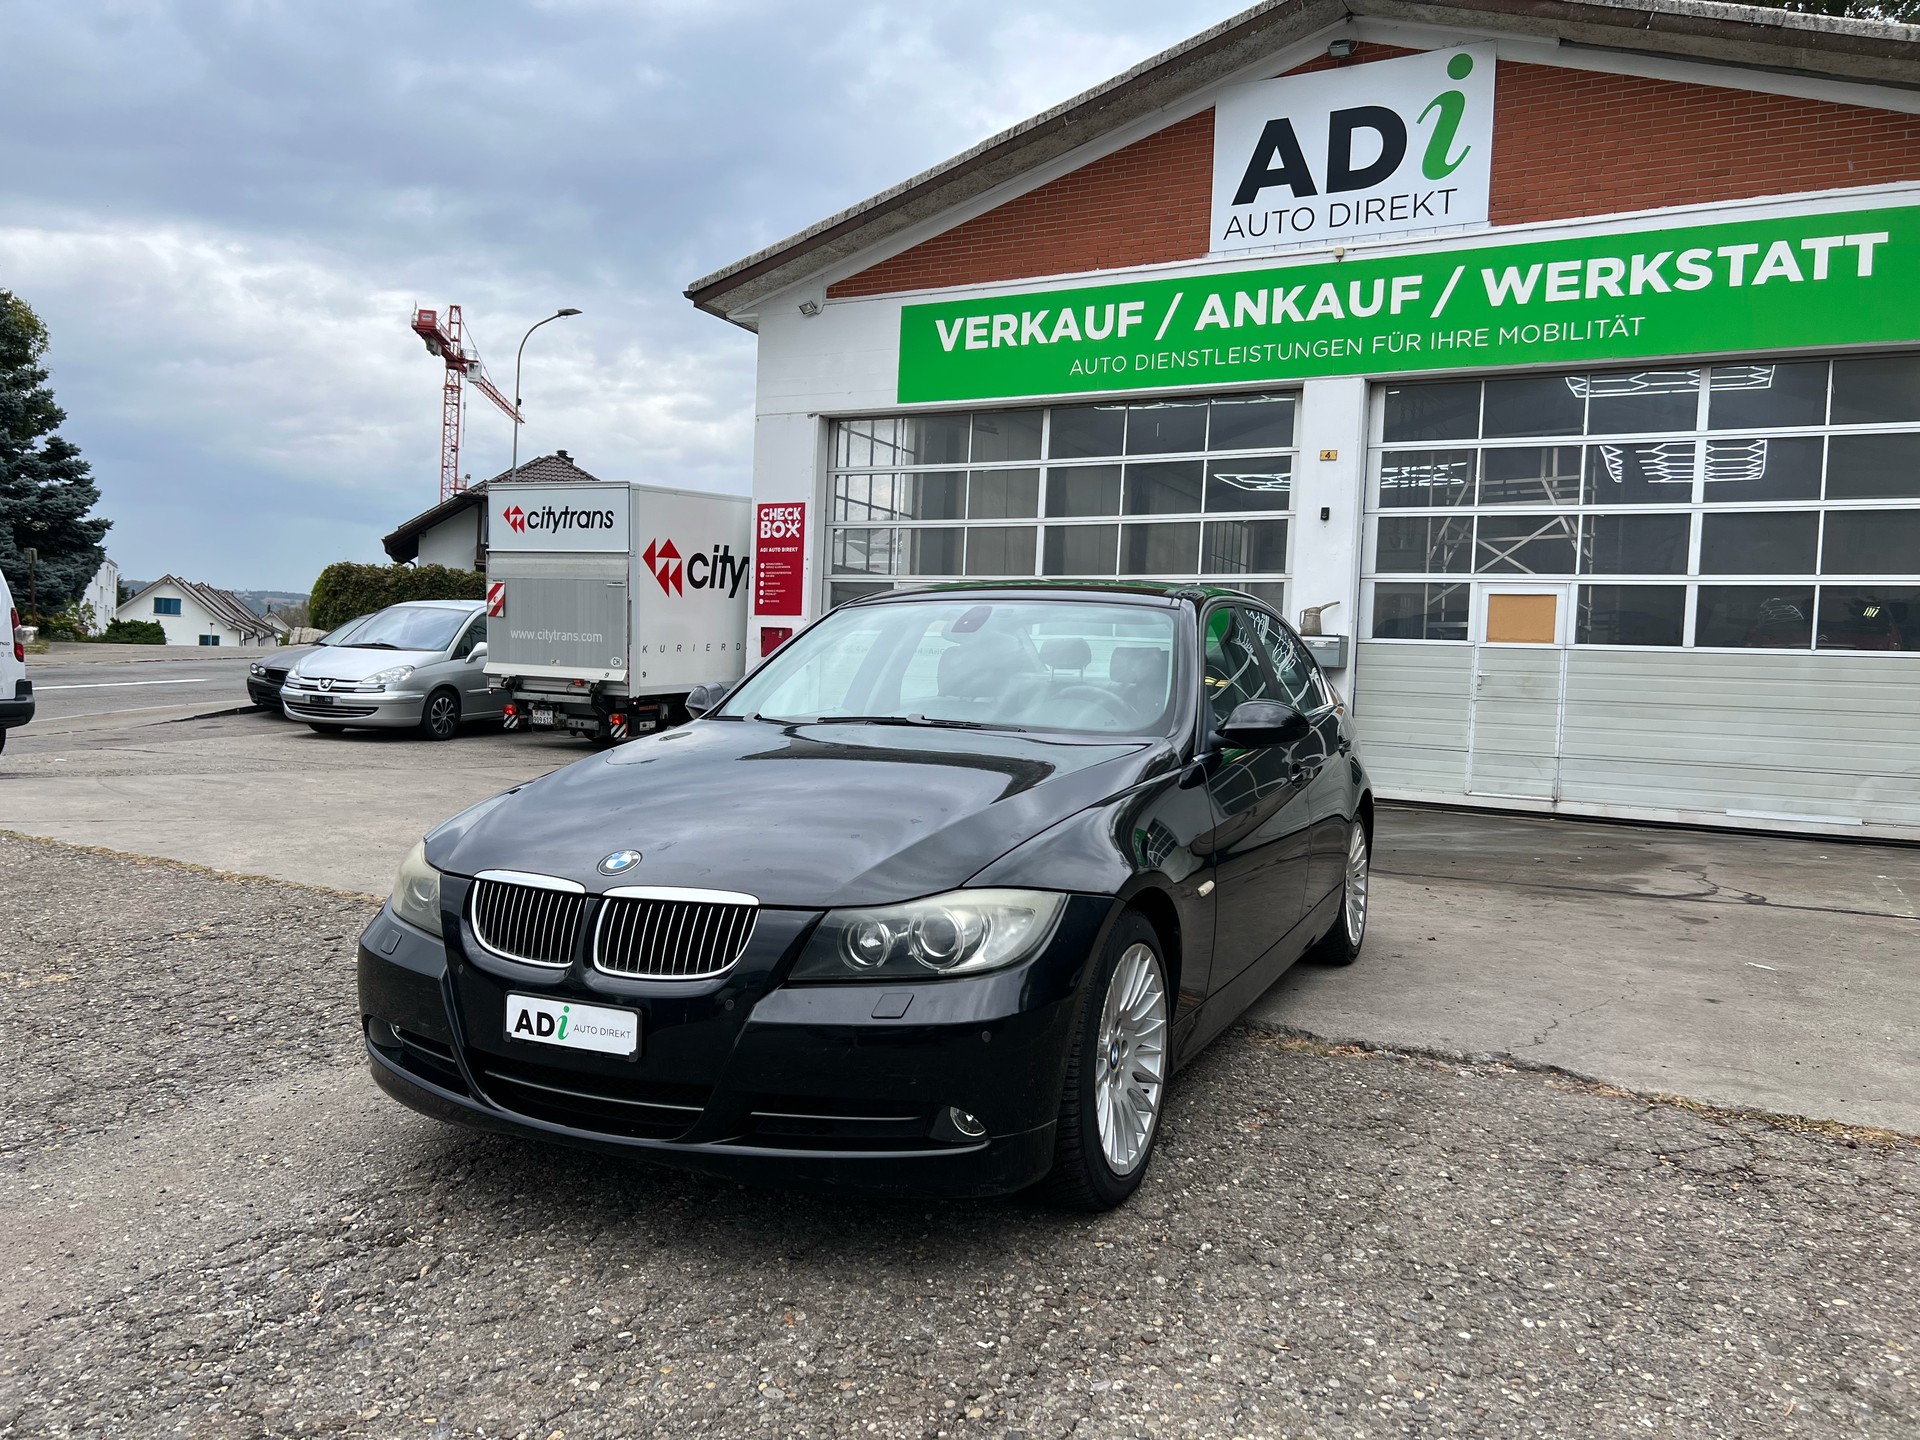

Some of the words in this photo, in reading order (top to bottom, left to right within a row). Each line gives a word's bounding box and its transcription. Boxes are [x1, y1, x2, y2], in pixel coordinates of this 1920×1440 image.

[1223, 206, 1315, 241] AUTO
[1328, 188, 1458, 229] DIREKT
[935, 300, 1145, 353] VERKAUF
[1193, 276, 1423, 332] ANKAUF
[1480, 231, 1889, 308] WERKSTATT
[1069, 356, 1127, 376] AUTO
[1135, 337, 1363, 371] DIENSTLEISTUNGEN
[1372, 331, 1421, 354] FÜR
[1430, 328, 1489, 350] IHRE
[1498, 315, 1646, 346] MOBILITÄT
[527, 505, 615, 534] citytrans
[760, 507, 802, 521] CHECK
[760, 520, 801, 539] BOX
[510, 628, 603, 644] www.citytrans.com
[612, 658, 621, 666] CH
[642, 671, 647, 679] 9
[573, 1024, 598, 1035] AUTO
[600, 1028, 632, 1039] DIREKT
